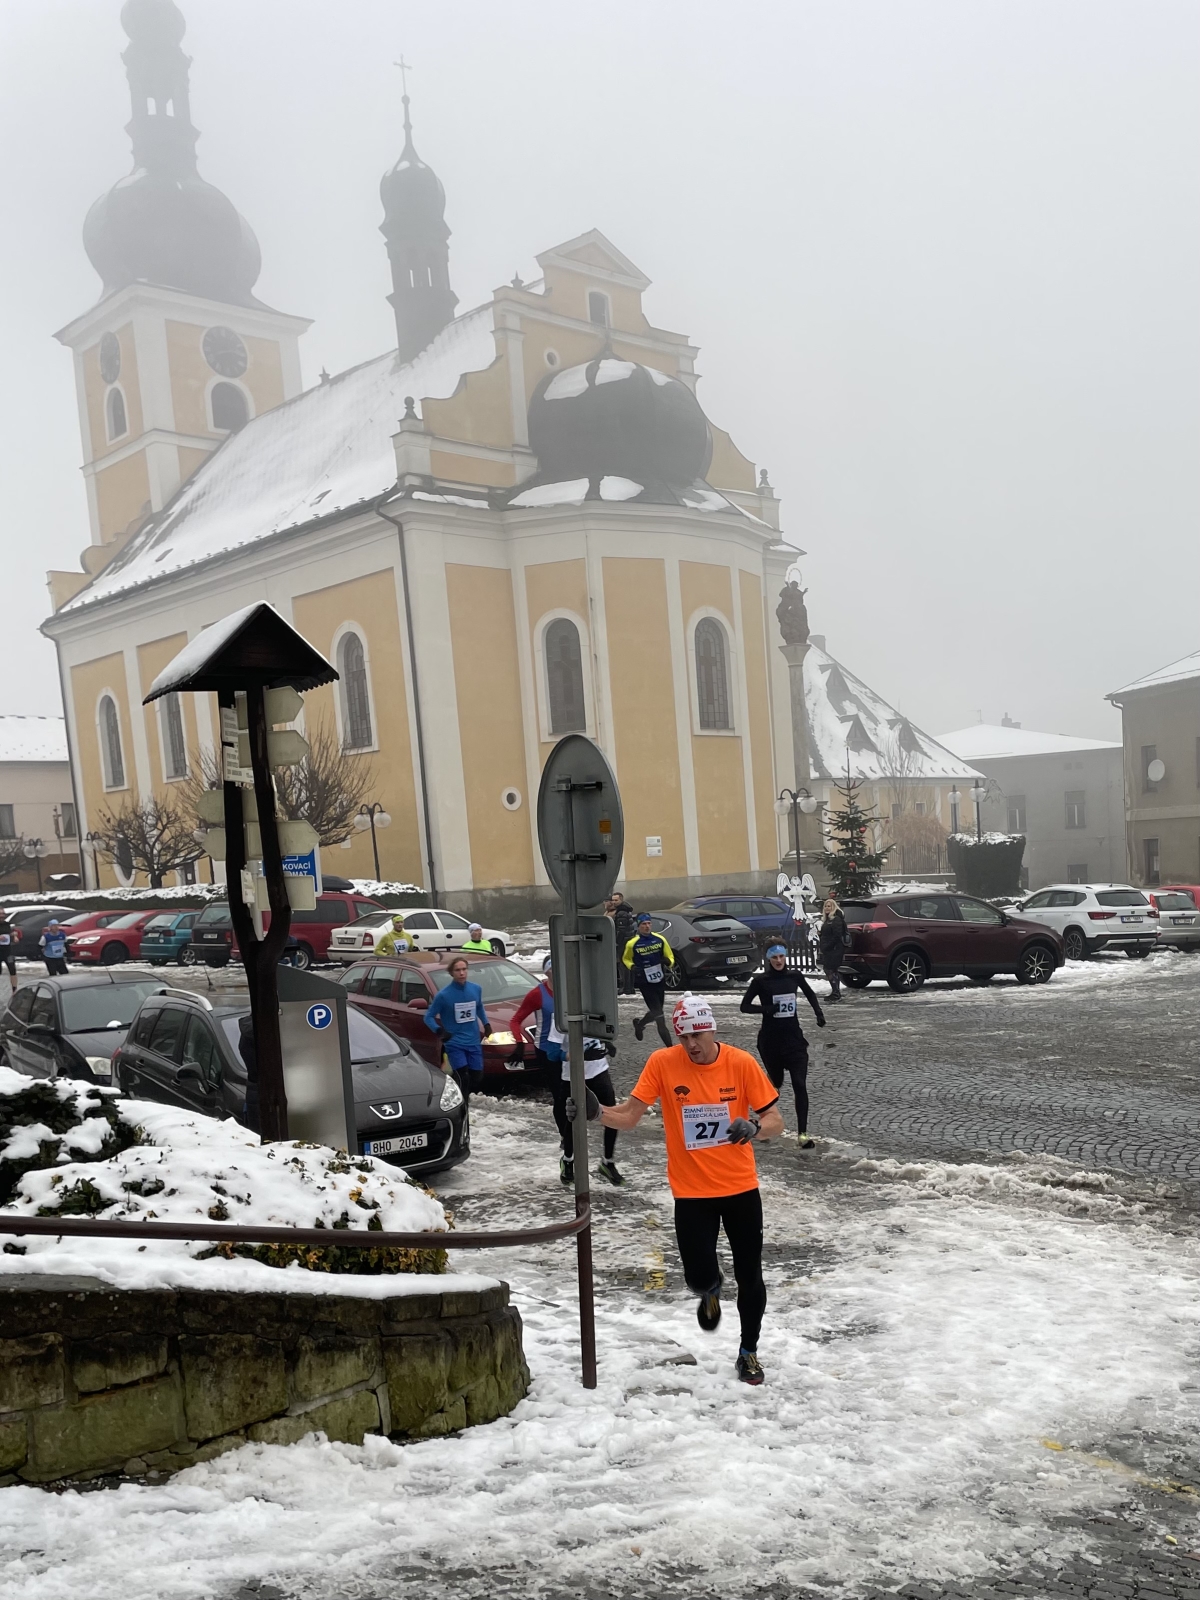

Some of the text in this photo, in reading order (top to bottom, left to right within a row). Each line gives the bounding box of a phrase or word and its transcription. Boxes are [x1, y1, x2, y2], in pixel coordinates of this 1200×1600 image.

[282, 861, 311, 871] KOVACÍ
[635, 943, 662, 954] TRUTNOV
[648, 971, 662, 981] 130
[313, 1008, 327, 1026] P
[459, 1009, 472, 1019] 26
[694, 1122, 720, 1140] 27
[399, 1135, 423, 1150] 2045
